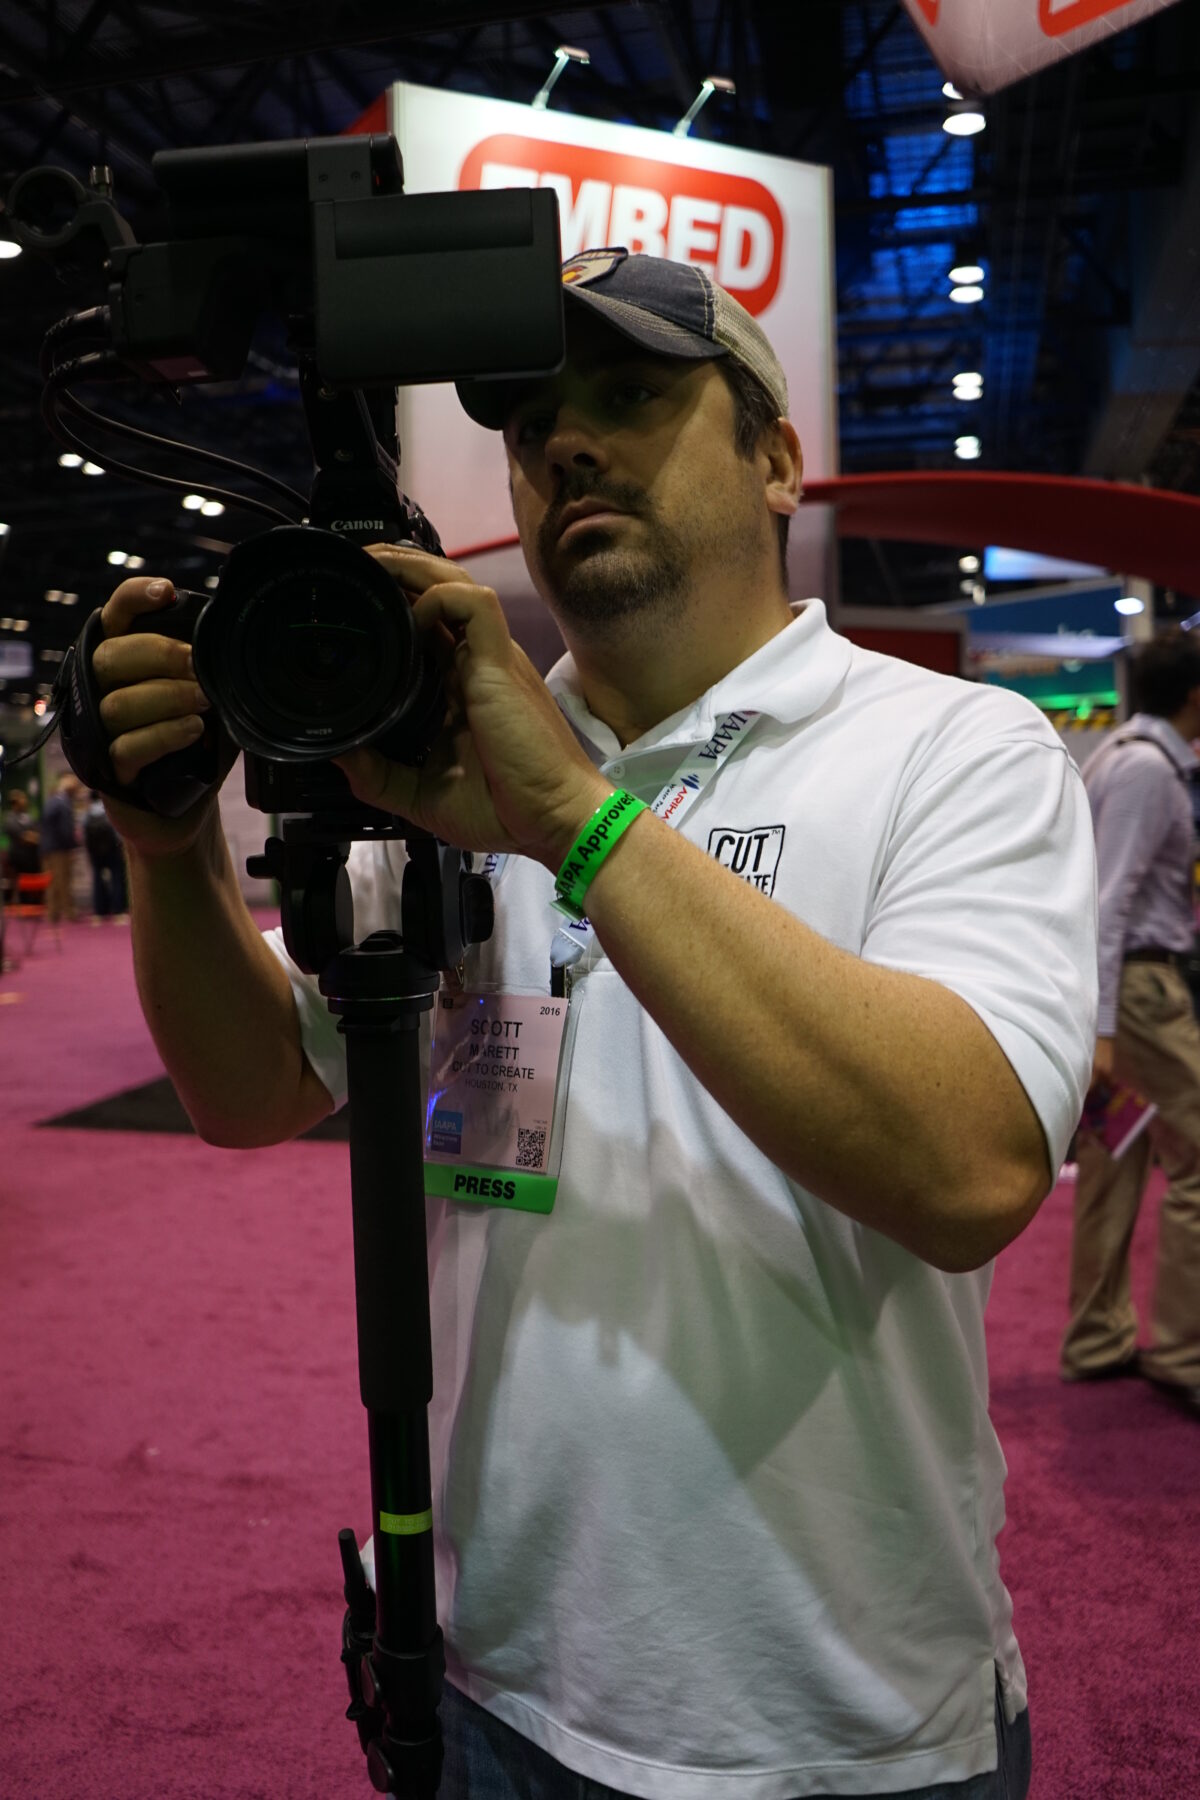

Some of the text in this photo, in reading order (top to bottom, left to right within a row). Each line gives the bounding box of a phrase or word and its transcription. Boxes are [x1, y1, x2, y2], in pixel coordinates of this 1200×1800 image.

[331, 519, 384, 531] Canon
[697, 711, 748, 760] IAAPA
[577, 788, 636, 862] Approved
[714, 834, 770, 874] CUT
[540, 1006, 561, 1016] 2016
[471, 1019, 523, 1038] SCOTT
[475, 1063, 489, 1076] TO
[491, 1064, 535, 1080] CREATE
[508, 1083, 519, 1093] TX
[454, 1174, 516, 1200] PRESS
